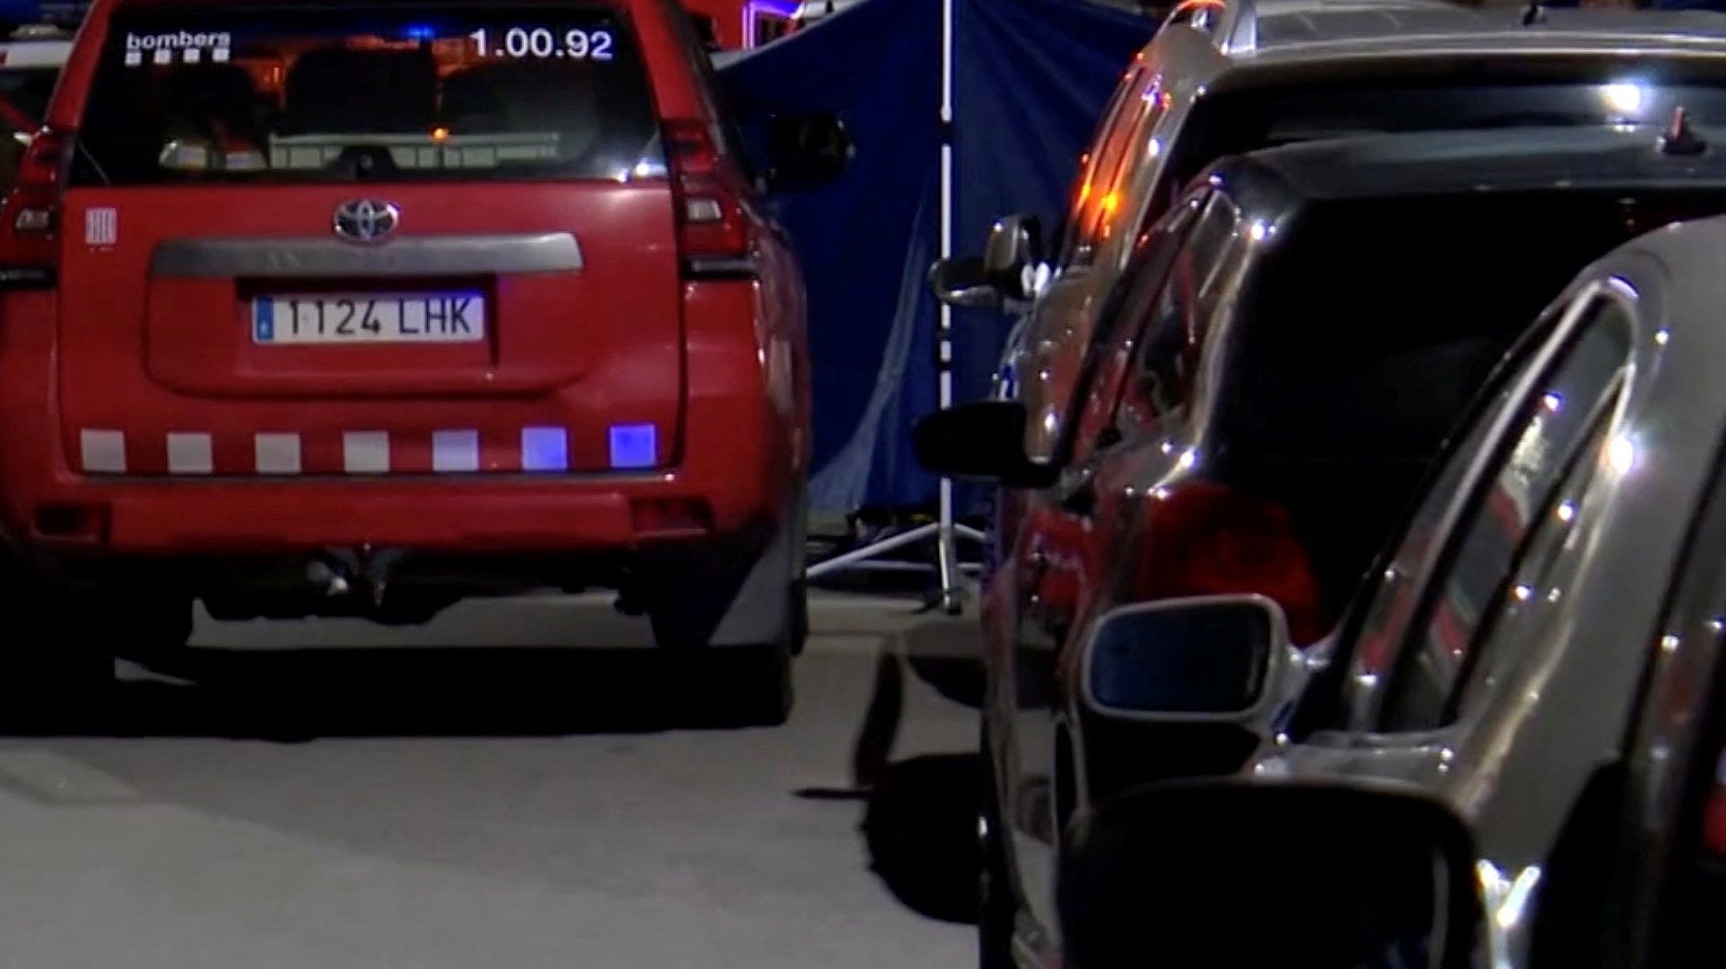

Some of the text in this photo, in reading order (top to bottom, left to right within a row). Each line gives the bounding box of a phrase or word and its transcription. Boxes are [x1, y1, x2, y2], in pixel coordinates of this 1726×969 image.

[126, 29, 231, 49] bombers
[468, 27, 614, 60] 1.00.92
[288, 297, 471, 335] 1124 LHK
